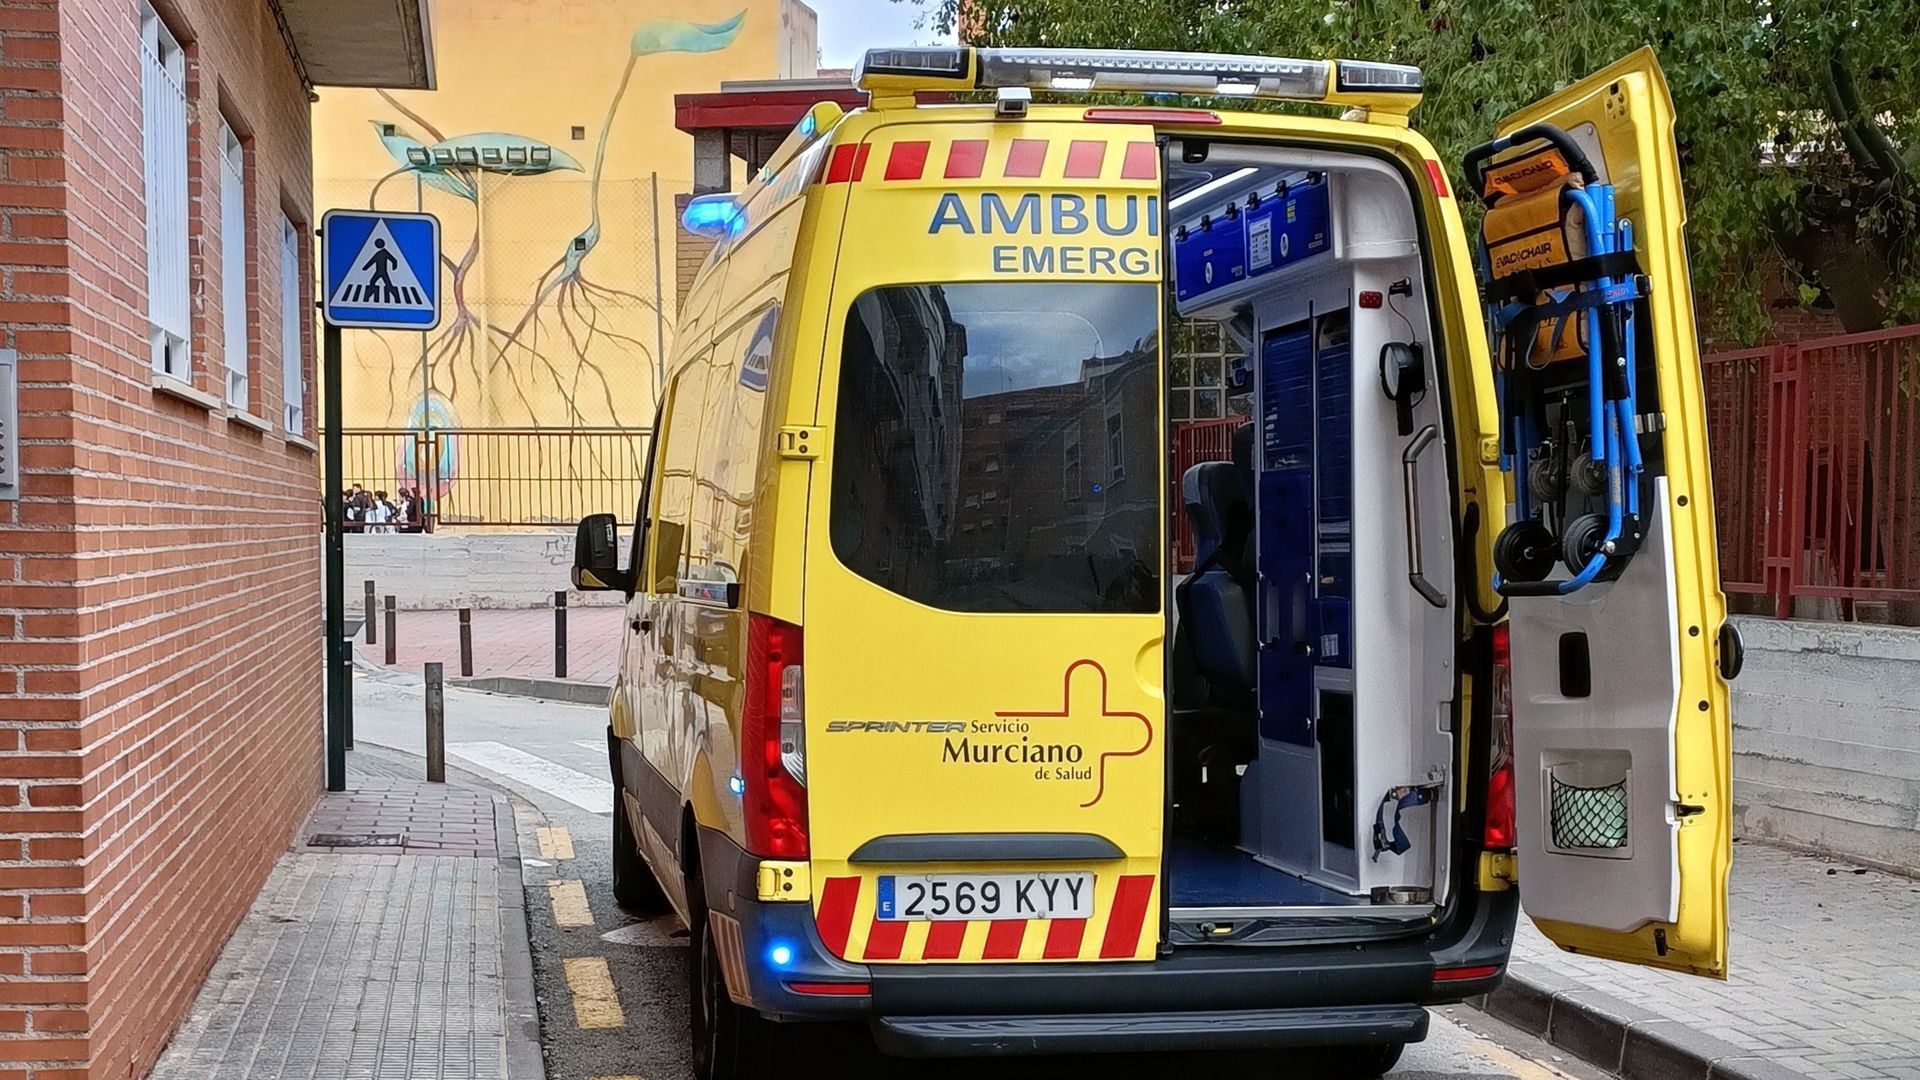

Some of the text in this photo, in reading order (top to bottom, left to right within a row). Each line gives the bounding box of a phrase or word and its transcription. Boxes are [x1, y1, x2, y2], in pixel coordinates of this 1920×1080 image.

[993, 246, 1159, 275] EMERG
[826, 720, 967, 733] SPRINTER
[971, 719, 1029, 734] Servicio
[942, 736, 1083, 763] Murciano
[1034, 767, 1092, 780] de Salud
[905, 877, 1084, 916] 2569 KYY
[882, 901, 891, 912] E
